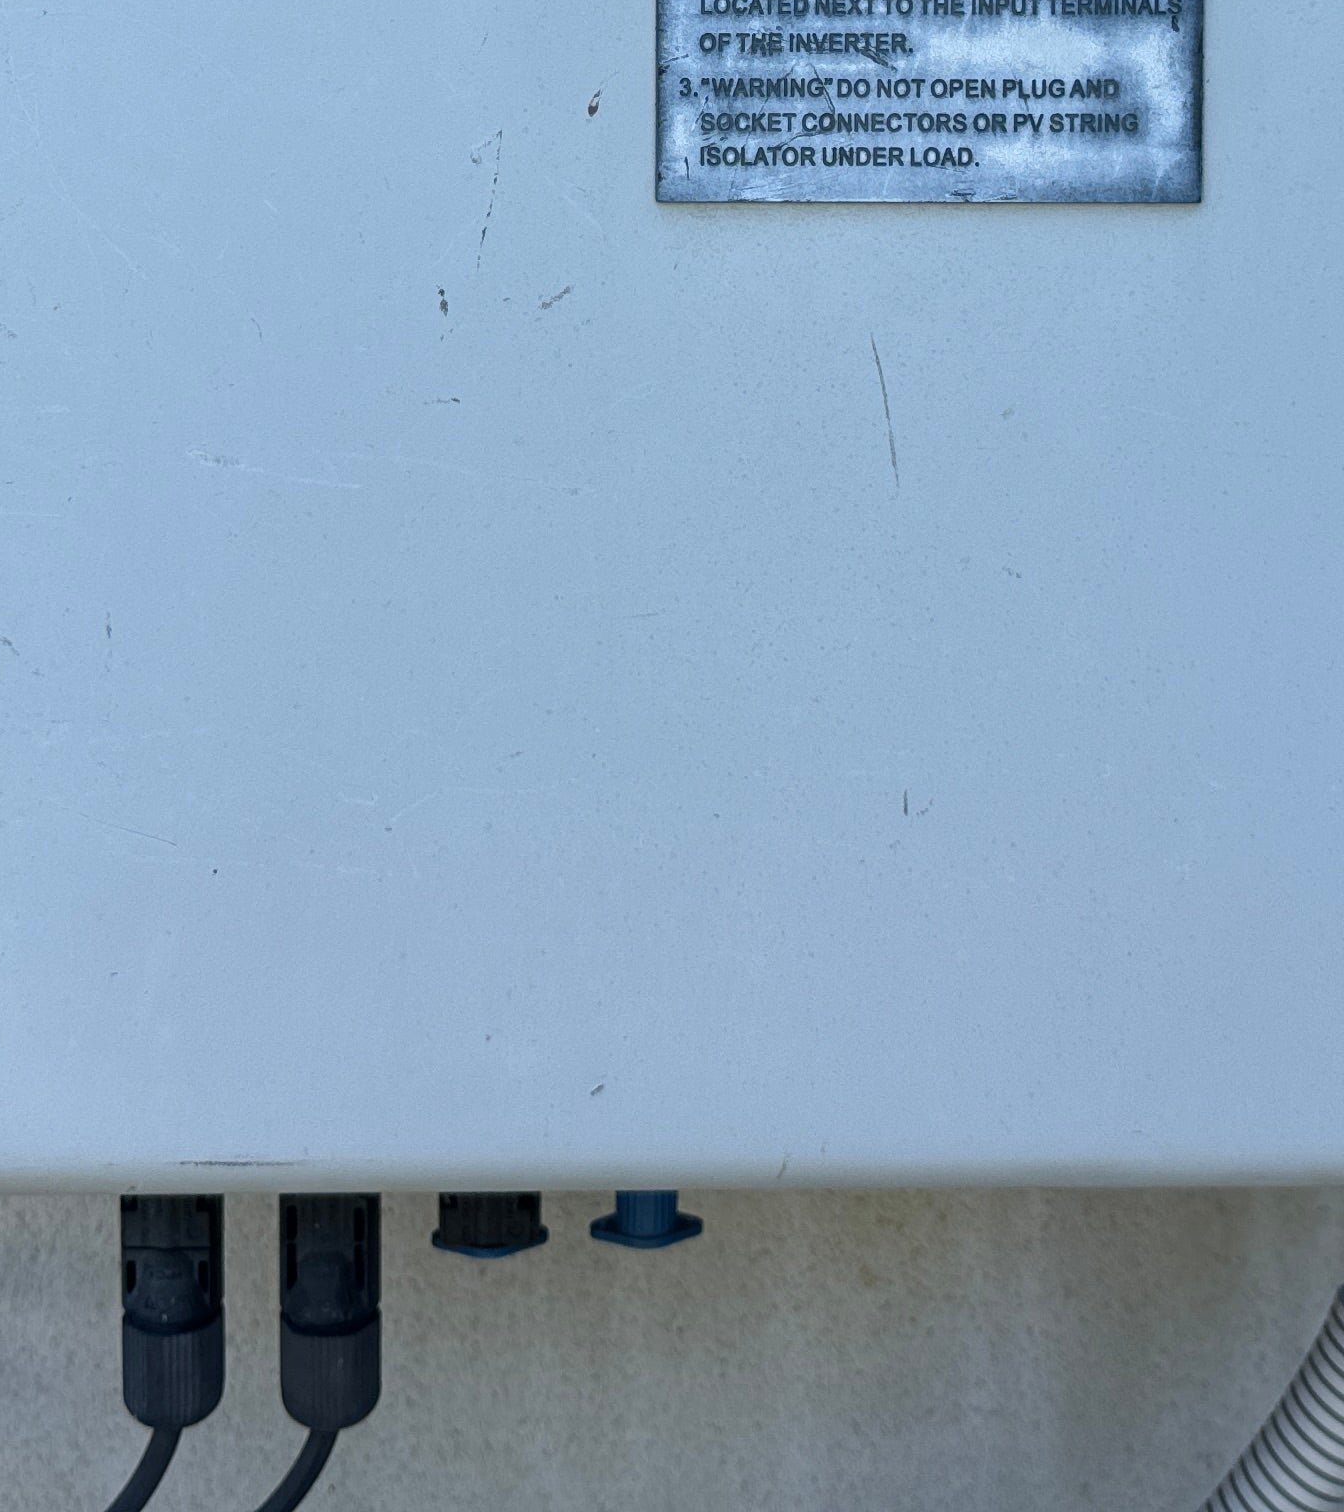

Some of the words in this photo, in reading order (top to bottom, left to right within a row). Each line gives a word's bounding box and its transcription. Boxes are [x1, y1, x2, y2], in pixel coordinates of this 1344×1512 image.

[699, 33, 732, 54] OF
[735, 33, 783, 54] THE
[789, 33, 914, 54] INVERTER.
[837, 78, 871, 98] DO
[877, 78, 925, 98] NOT
[930, 78, 996, 98] OPEN
[1002, 78, 1065, 98] PLUG
[1069, 78, 1120, 98] AND
[700, 113, 797, 133] SOCKET
[801, 113, 967, 133] CONNECTORS
[972, 113, 1007, 133] OR
[1013, 113, 1044, 133] PV
[1049, 113, 1139, 133] STRING
[700, 147, 816, 167] ISOLATOR
[822, 147, 904, 167] UNDER
[910, 147, 980, 167] LOAD.
